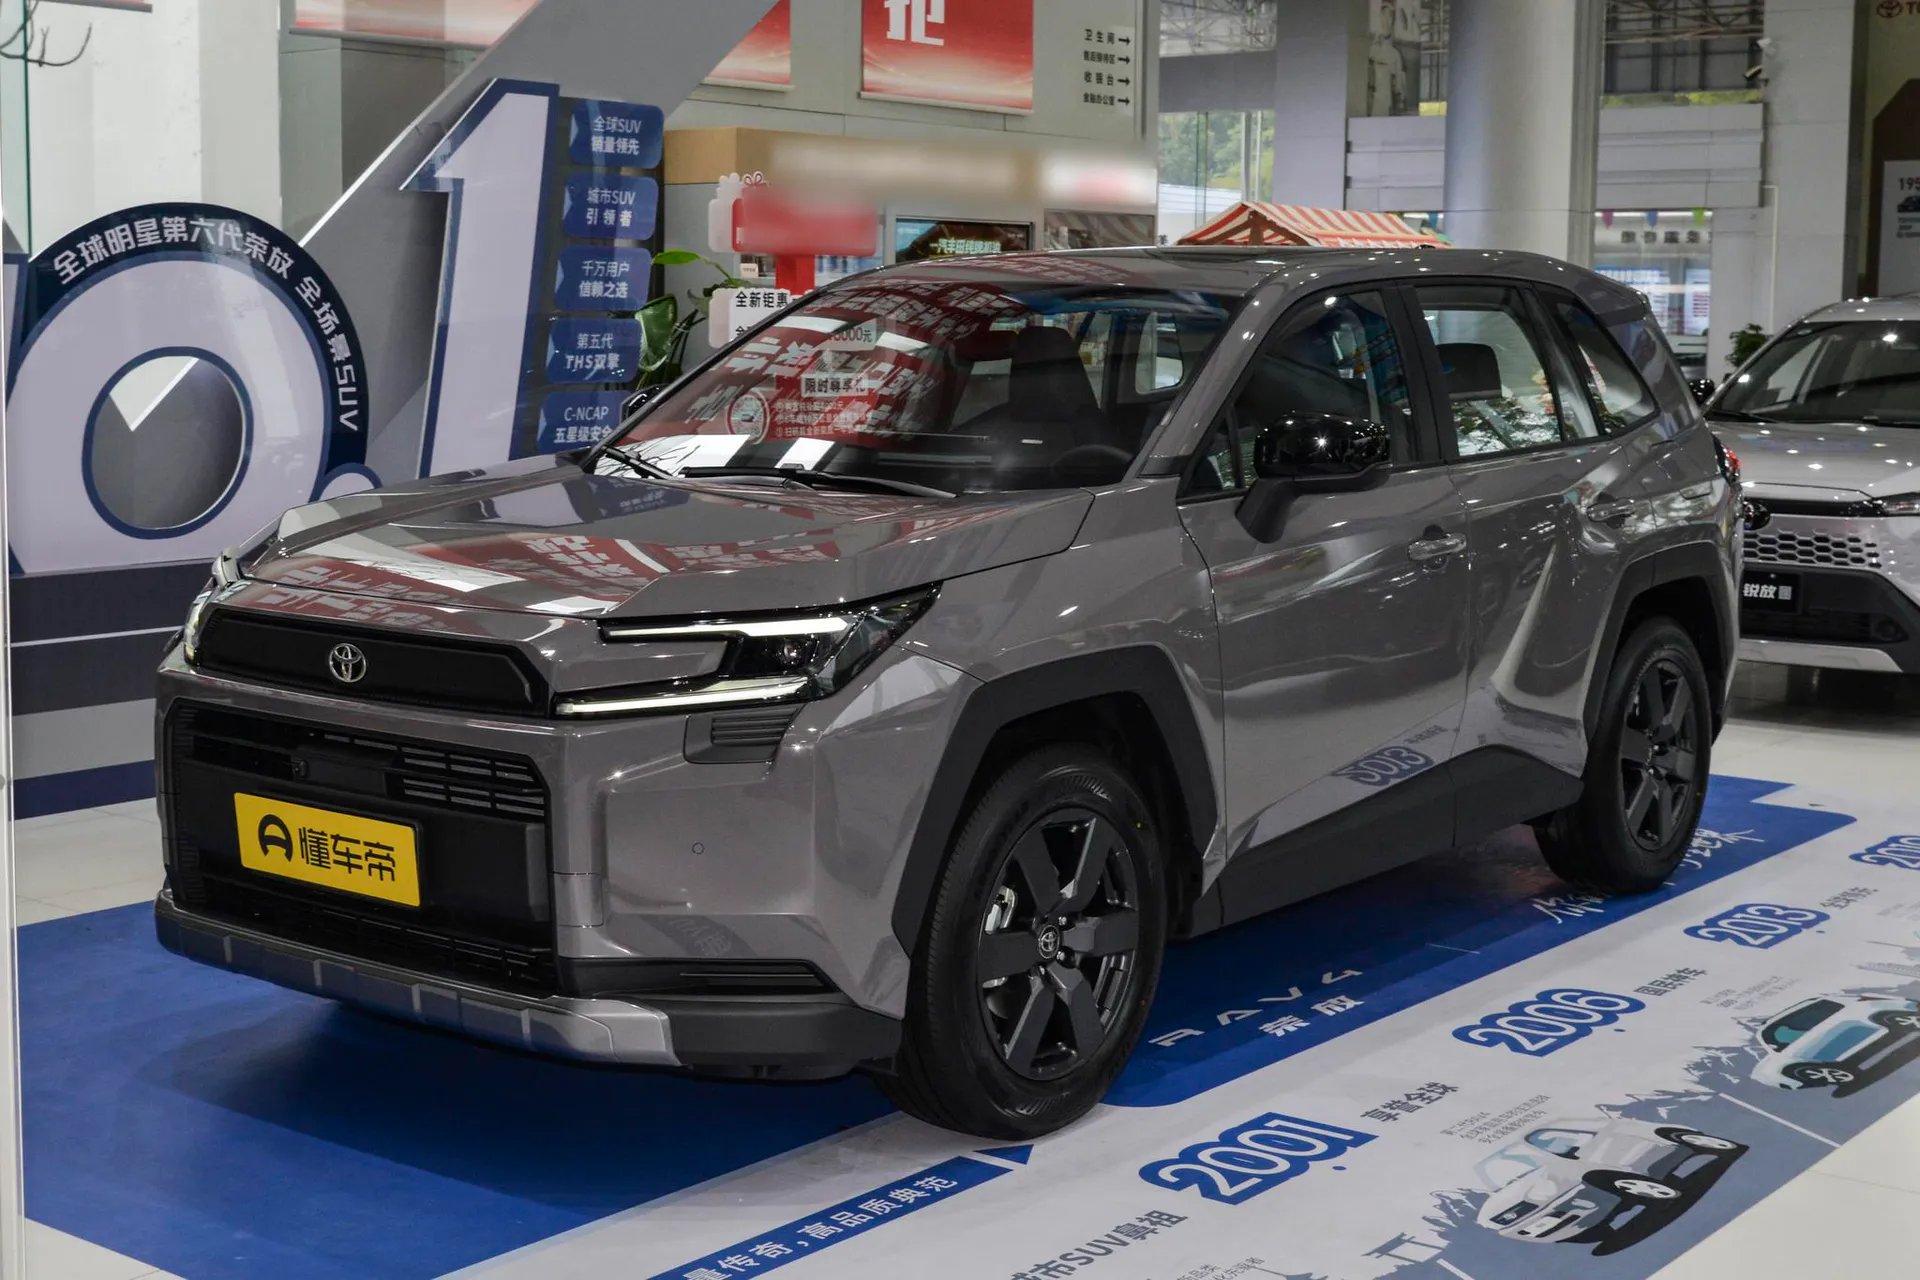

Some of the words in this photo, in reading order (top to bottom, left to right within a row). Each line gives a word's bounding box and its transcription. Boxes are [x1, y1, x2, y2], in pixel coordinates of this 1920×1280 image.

[1085, 28, 1115, 45] 卫生间
[593, 115, 641, 133] 全球SUV
[591, 136, 640, 155] 销量领先
[587, 187, 636, 205] 城市SUV
[581, 260, 630, 277] 千万用户
[579, 281, 628, 298] 信赖之选
[53, 216, 295, 285] 全球明星第六代荣放
[295, 276, 359, 431] 全场景SUV
[577, 333, 614, 350] 第五代
[565, 352, 620, 370] THS双擎
[563, 406, 609, 421] C-NCAP
[1743, 583, 1777, 599] 锐放
[299, 827, 396, 882] 懂车帝
[1696, 904, 1818, 947] 2013
[1258, 994, 1366, 1038] 荣放
[1467, 991, 1631, 1052] 2006
[1360, 1081, 1459, 1123] 享誉全球
[1156, 1118, 1355, 1197] 2001
